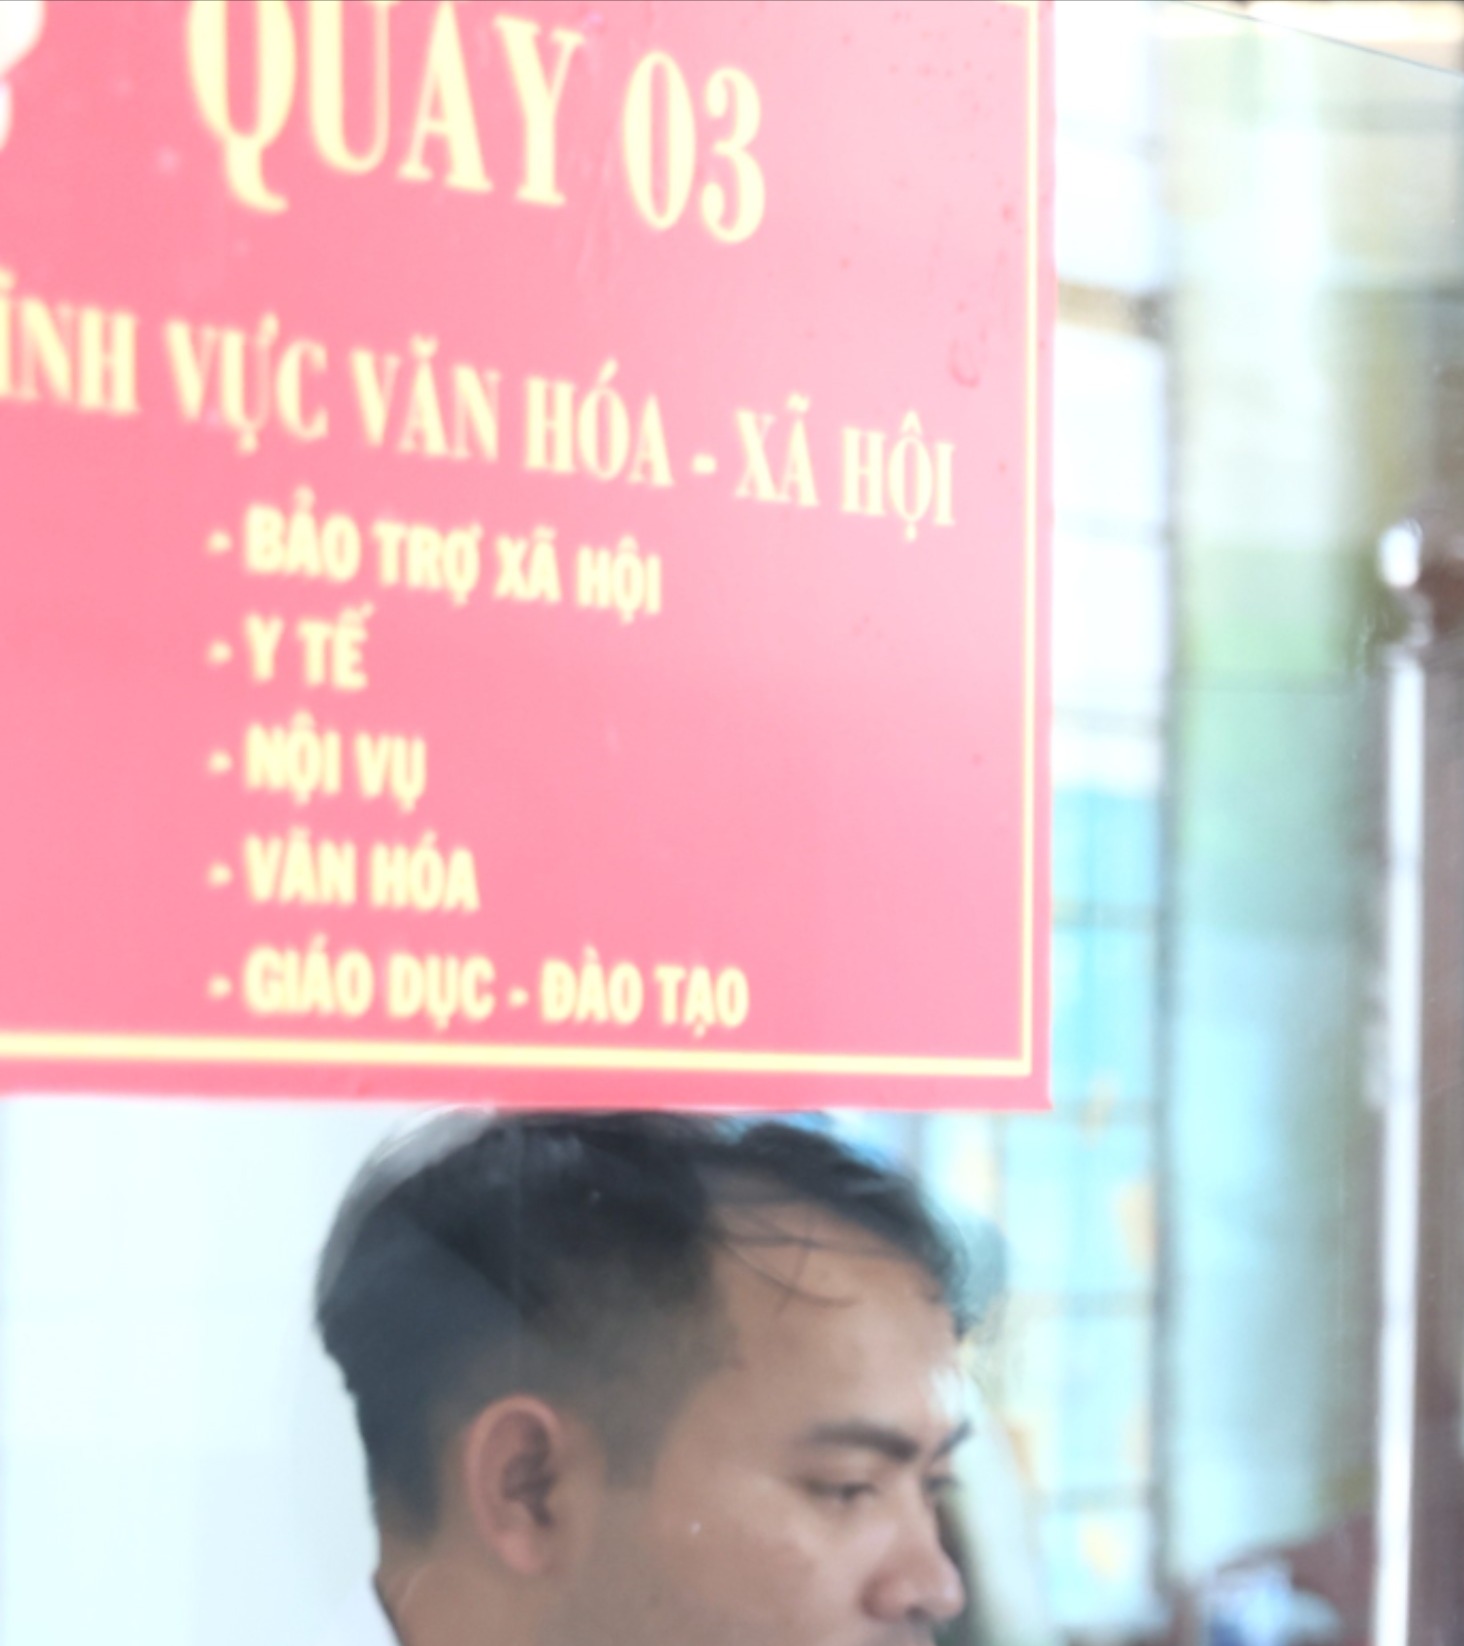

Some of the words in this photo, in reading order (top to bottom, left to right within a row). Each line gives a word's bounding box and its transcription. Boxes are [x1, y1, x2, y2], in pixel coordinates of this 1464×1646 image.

[622, 50, 765, 243] 03
[164, 310, 328, 456] VỰC
[351, 335, 500, 463] VĂN
[524, 357, 674, 490] HÓA
[734, 393, 819, 509] XÃ
[839, 409, 956, 541] HỘI
[244, 484, 361, 581] BẢO
[374, 519, 483, 606] TRỢ
[494, 525, 562, 605] XÃ
[577, 535, 661, 624] HỘI
[245, 615, 283, 682] Y
[300, 603, 374, 690] TẾ
[245, 709, 341, 805] NỘI
[355, 733, 426, 811] VỤ
[244, 826, 356, 905] VĂN
[370, 830, 480, 913] HÓA
[244, 933, 373, 1017] GIÁO
[388, 953, 495, 1031] DỤC
[540, 946, 642, 1027] ĐÀO
[654, 963, 750, 1038] TẠO
